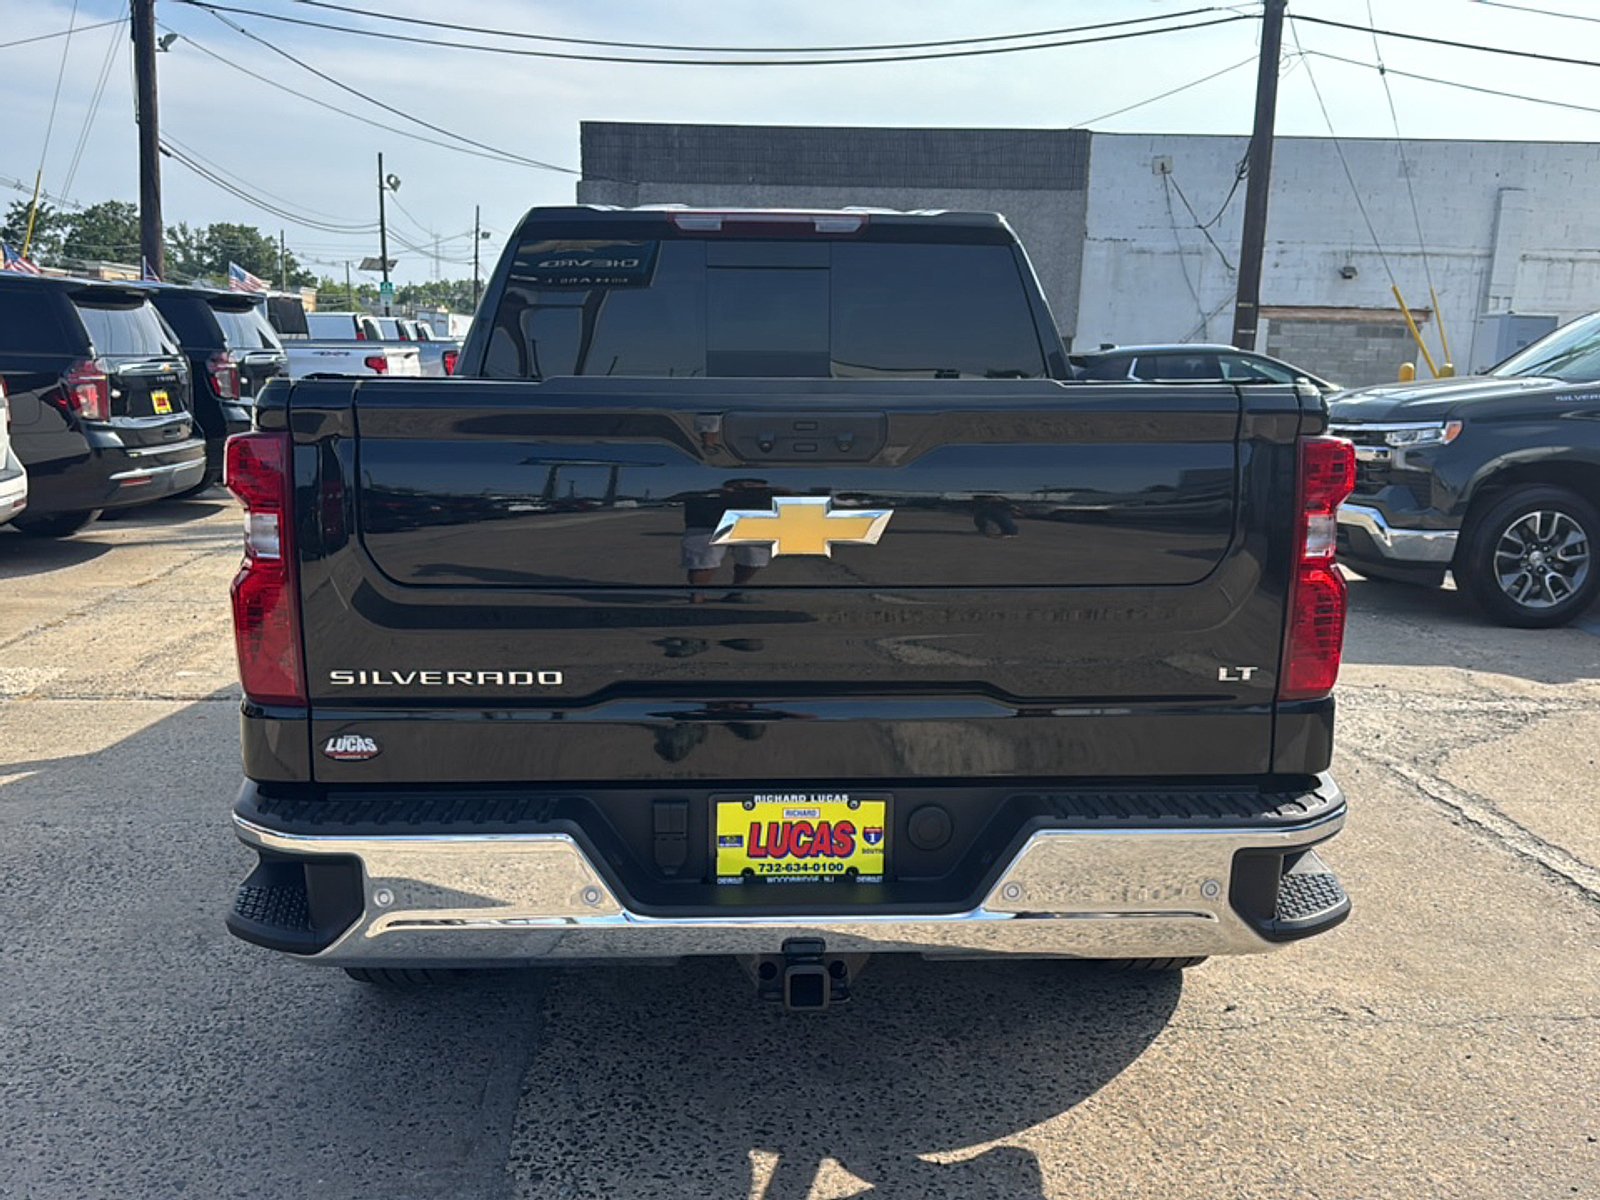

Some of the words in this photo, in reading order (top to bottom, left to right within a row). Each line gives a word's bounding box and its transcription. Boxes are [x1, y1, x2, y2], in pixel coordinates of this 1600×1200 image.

[1554, 393, 1600, 401] SILVER
[329, 670, 564, 686] SILVERADO
[1218, 666, 1259, 681] LT
[325, 737, 378, 753] LUCAS
[754, 794, 807, 804] RICHARD
[810, 794, 850, 804] LUCAS
[747, 819, 857, 859] LUCAS
[869, 833, 876, 843] 1
[758, 863, 845, 873] 732-634-0100
